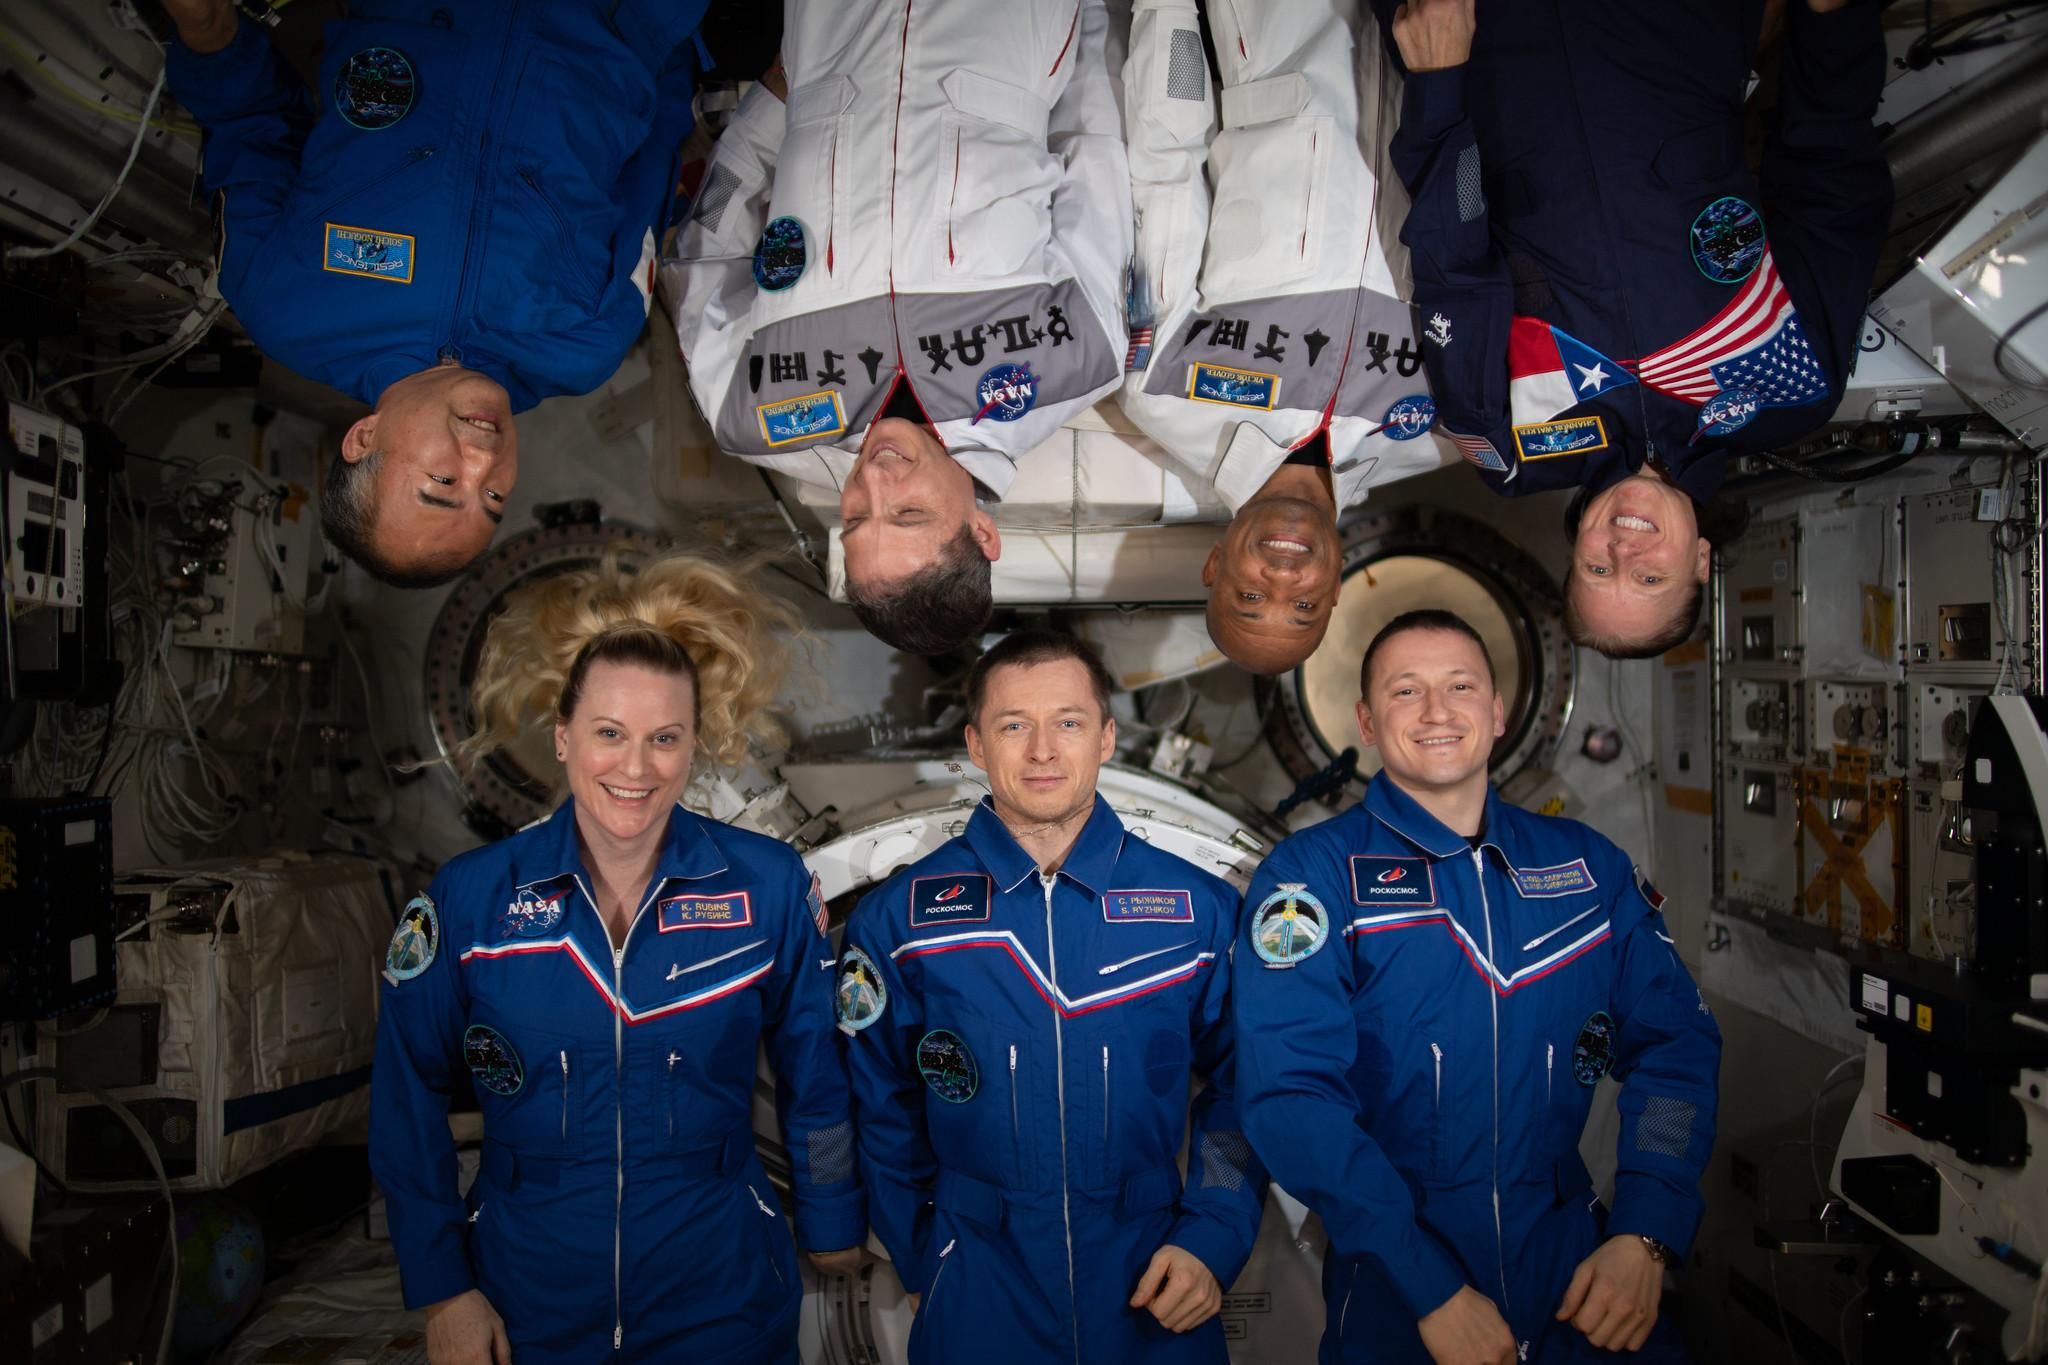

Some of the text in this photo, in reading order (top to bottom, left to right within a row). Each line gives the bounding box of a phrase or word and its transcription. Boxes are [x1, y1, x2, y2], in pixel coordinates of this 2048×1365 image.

[336, 230, 403, 247] SOICHI NOGUCHI
[334, 249, 404, 272] RESILIENCE
[1206, 368, 1265, 385] VICTOR GLOVER
[980, 382, 1033, 404] NASA
[1199, 383, 1265, 401] RESILIENCE
[765, 395, 830, 416] MICHAEL HOPKINS
[1701, 401, 1756, 425] NASA
[773, 413, 833, 435] RESILIENCE
[1390, 412, 1433, 424] NASA
[1519, 425, 1553, 436] WALKER
[1527, 433, 1596, 452] RESILIENCE
[1370, 887, 1419, 895] РОСКОСМОС
[507, 900, 561, 915] NASA
[695, 902, 730, 911] RUBINS
[925, 904, 974, 914] РОСКОСМОС
[1130, 897, 1176, 905] РЫЖИКОВ
[694, 911, 732, 920] РУБИНС
[1132, 906, 1175, 914] RYZHIKOV
